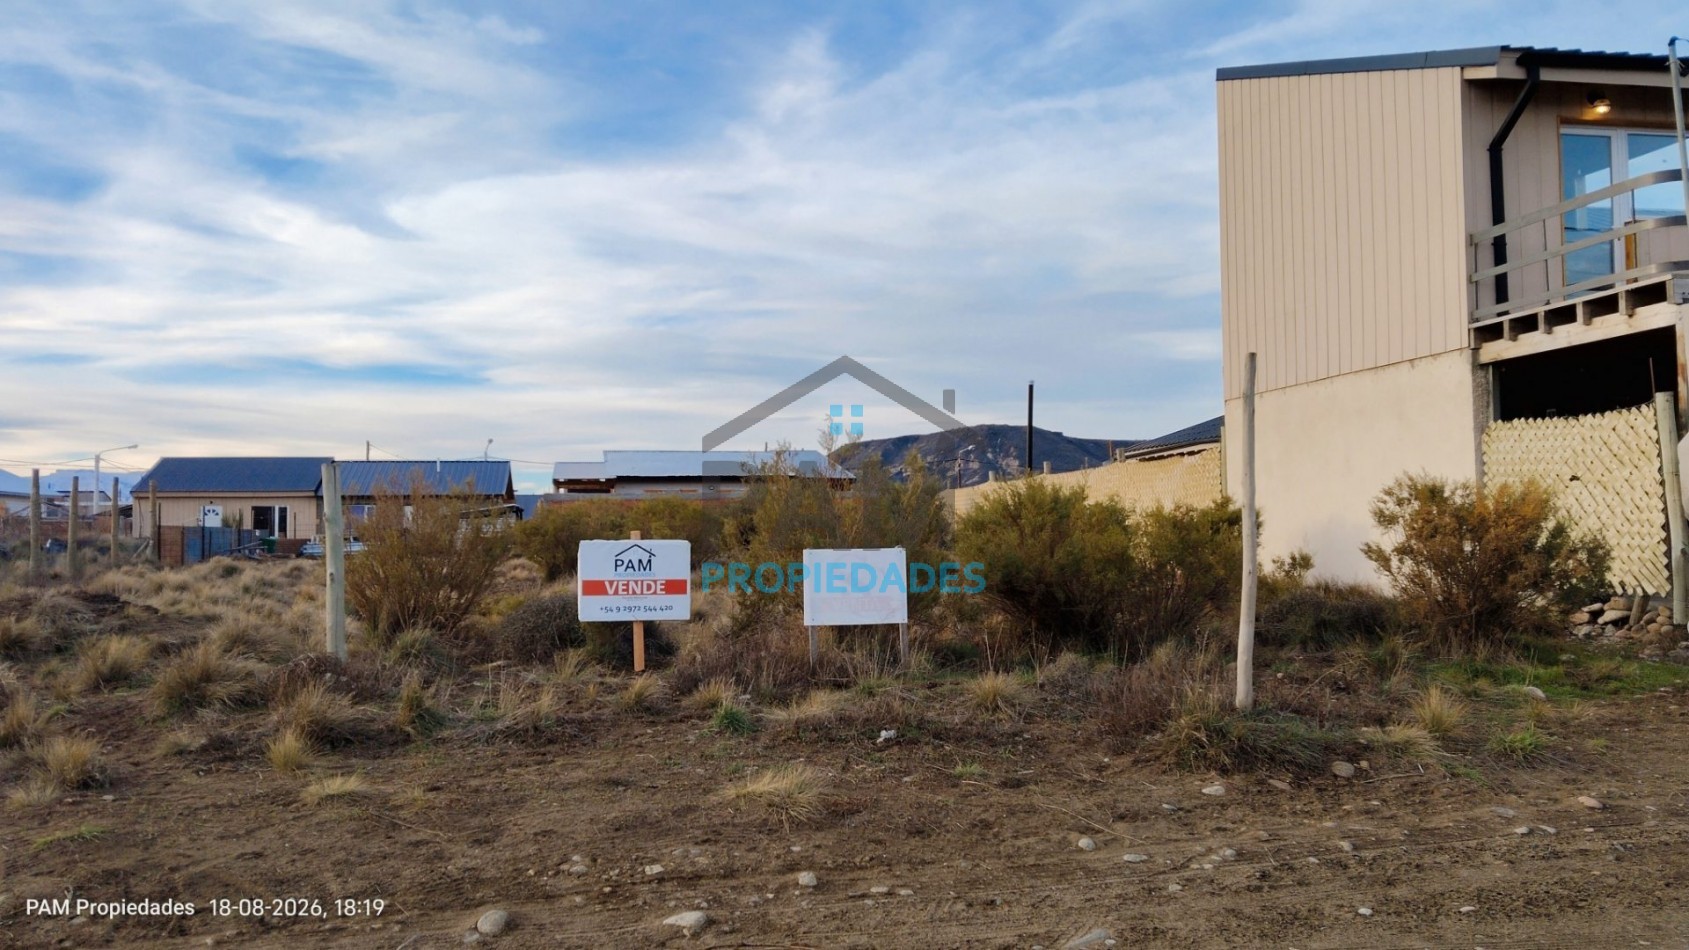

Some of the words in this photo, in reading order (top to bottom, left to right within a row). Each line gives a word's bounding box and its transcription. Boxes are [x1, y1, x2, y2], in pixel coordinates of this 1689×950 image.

[614, 558, 652, 572] PAM
[604, 580, 666, 595] VENDE
[600, 605, 613, 613] +54
[615, 605, 621, 613] 9
[623, 605, 641, 613] 2972
[659, 604, 673, 612] 420
